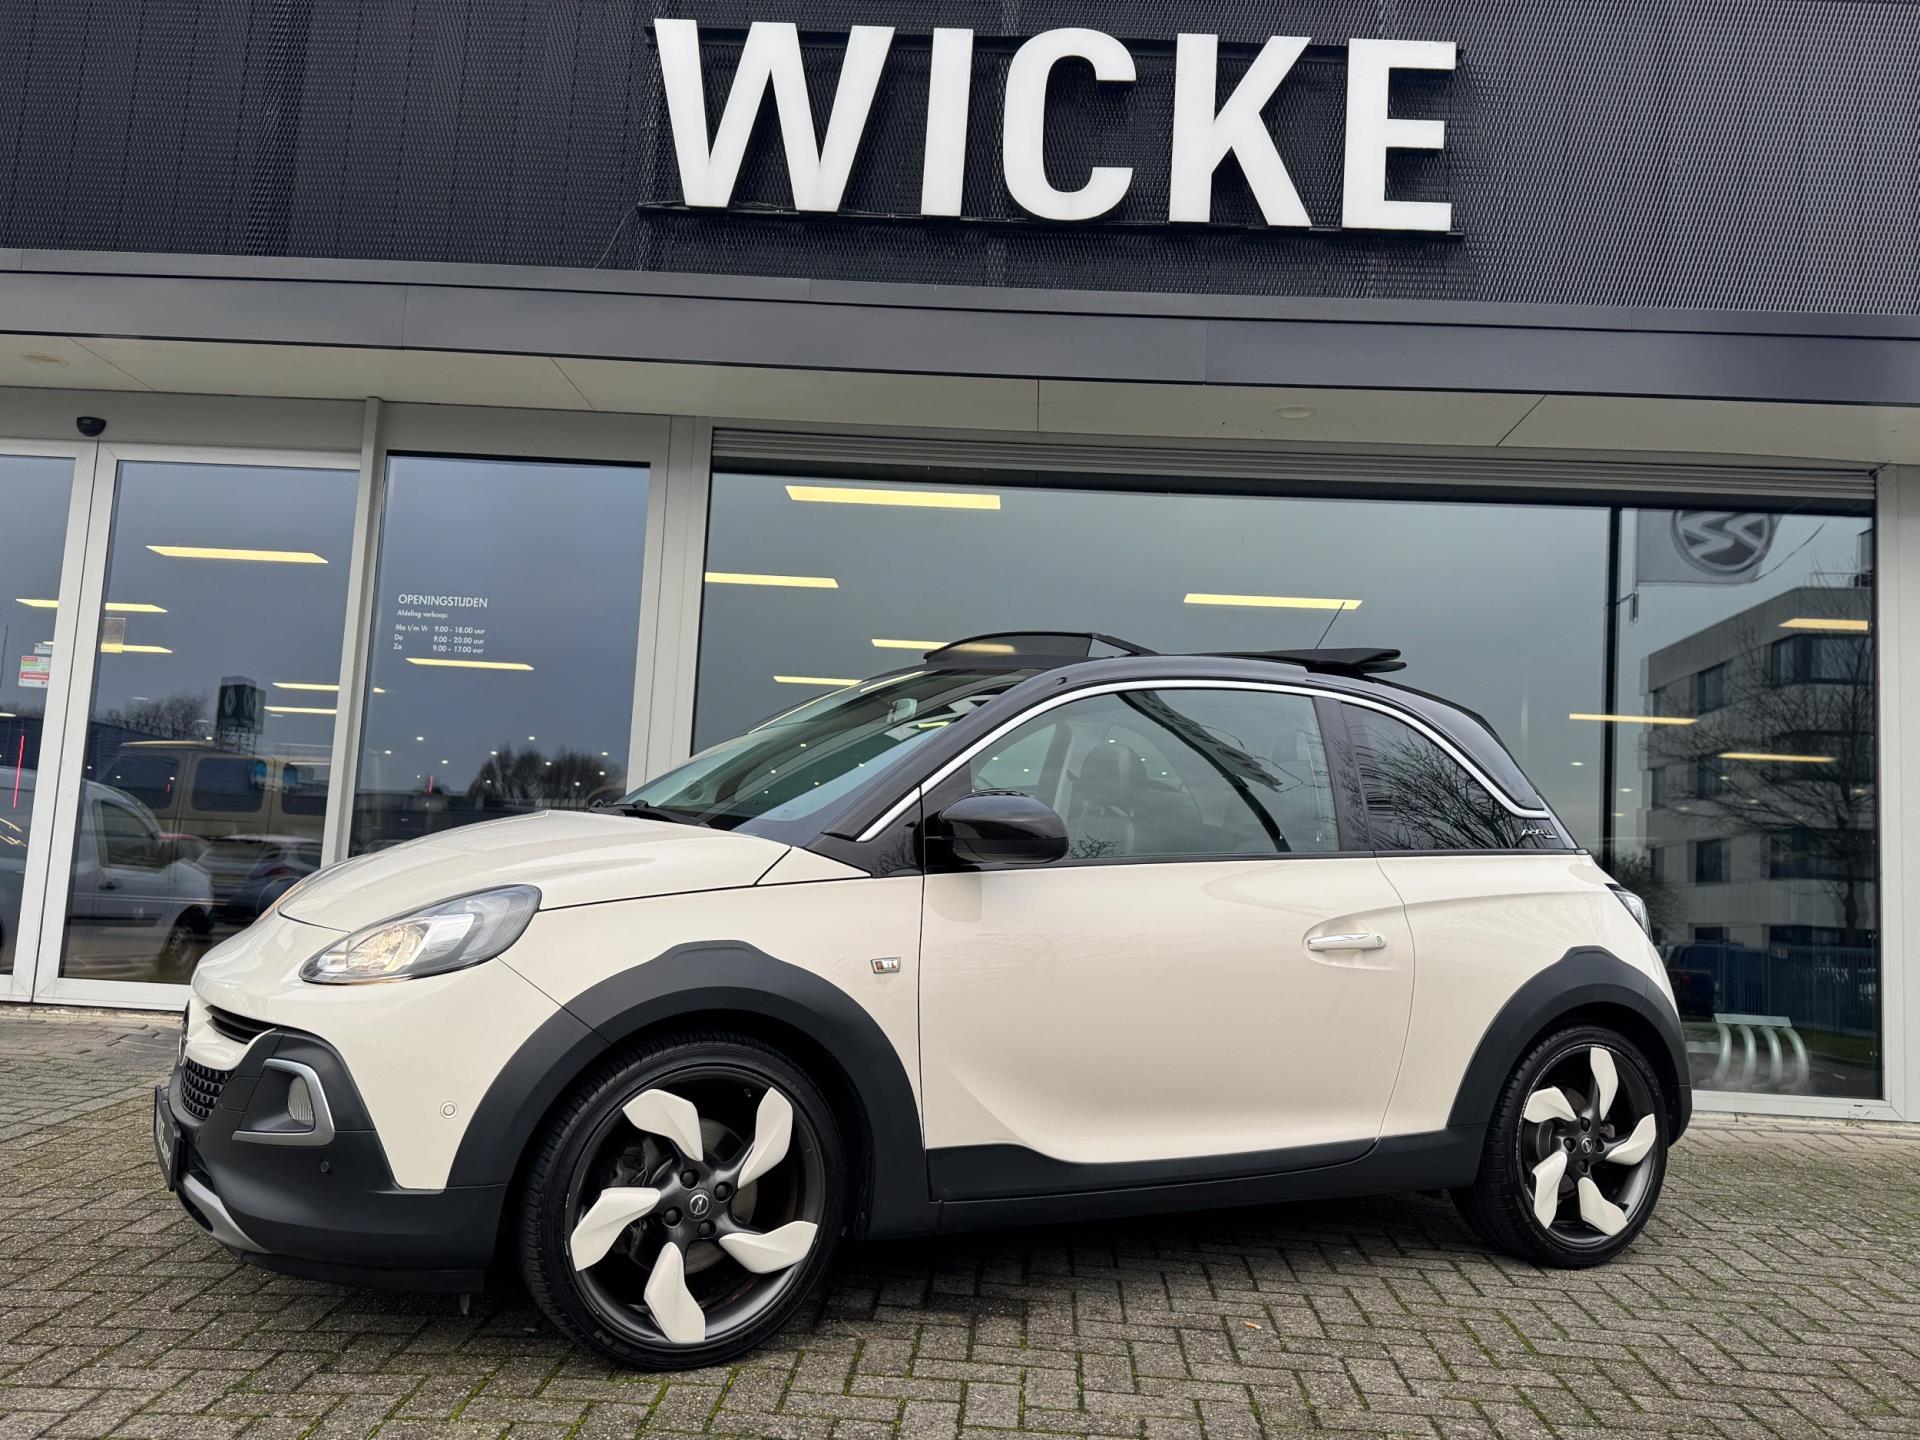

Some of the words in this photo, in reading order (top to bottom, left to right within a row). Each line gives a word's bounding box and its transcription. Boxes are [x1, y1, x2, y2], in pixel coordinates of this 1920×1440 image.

[653, 18, 1458, 232] WICKE
[398, 594, 488, 608] OPENINGSTIJDEN
[455, 626, 473, 634] 18.00
[433, 635, 447, 643] 9.00
